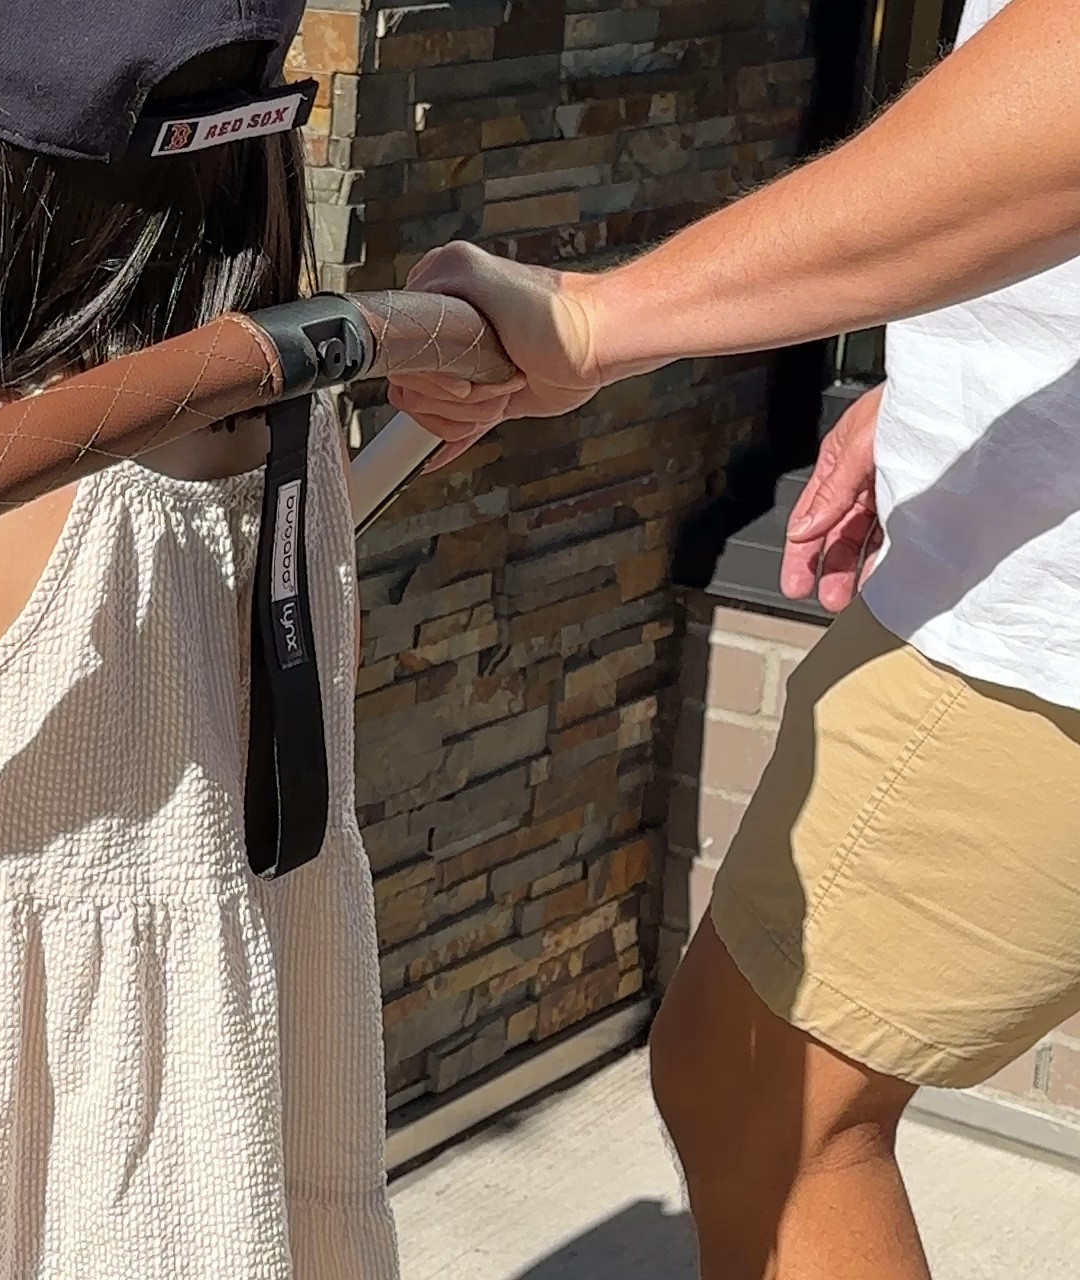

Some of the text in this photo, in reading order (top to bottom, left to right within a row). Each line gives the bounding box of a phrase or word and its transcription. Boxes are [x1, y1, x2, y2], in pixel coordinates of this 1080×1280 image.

[204, 116, 242, 140] RED
[247, 106, 290, 129] SOX
[280, 602, 298, 652] lynx
